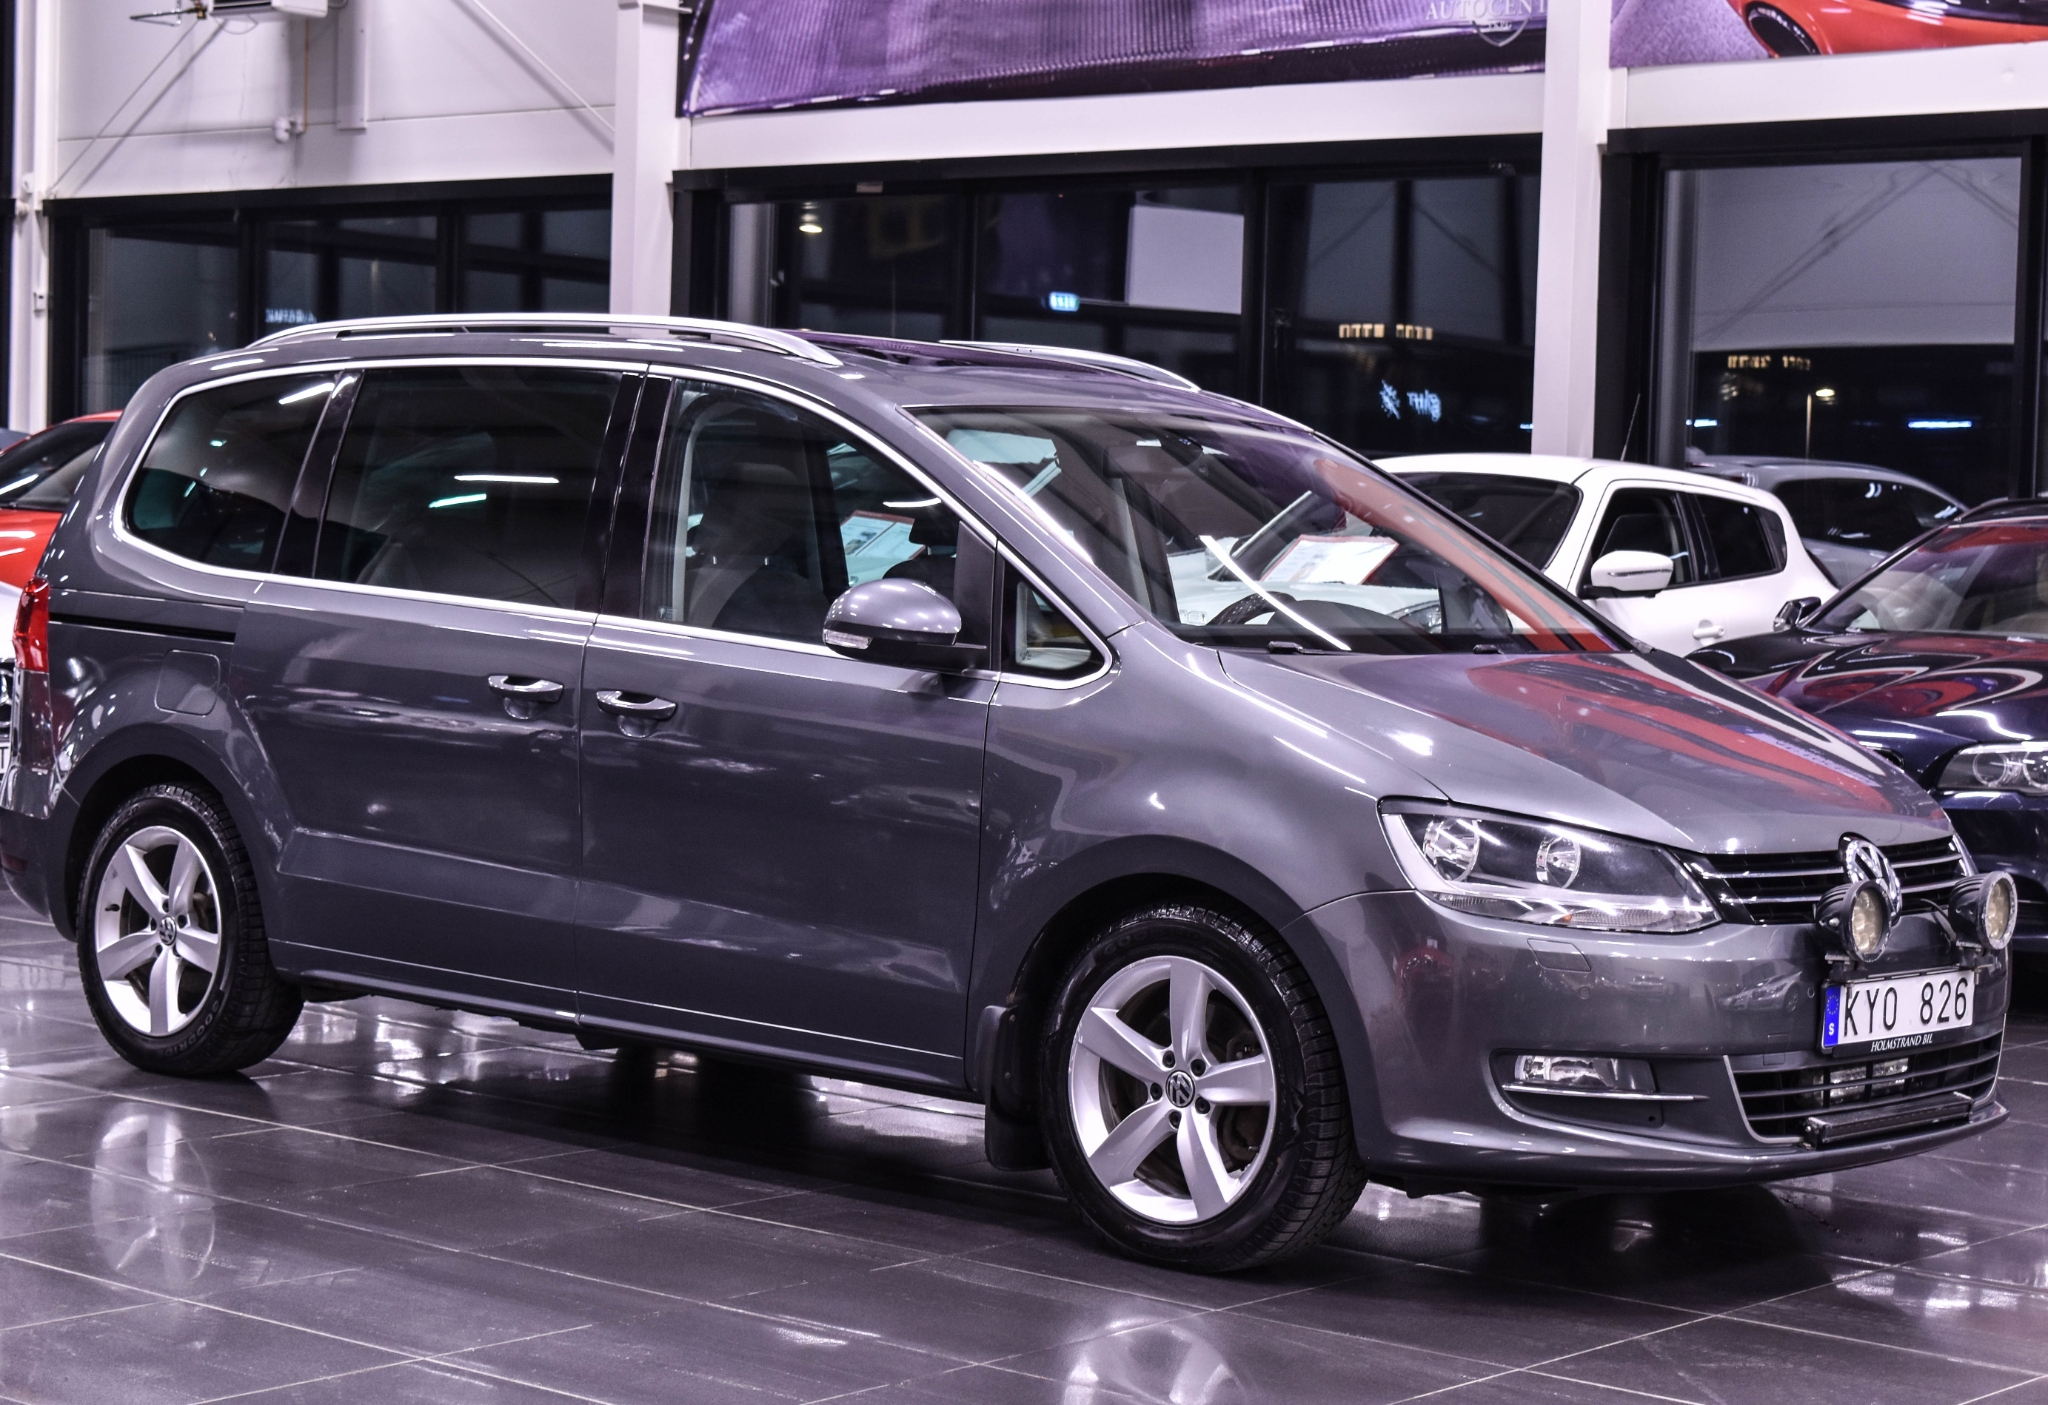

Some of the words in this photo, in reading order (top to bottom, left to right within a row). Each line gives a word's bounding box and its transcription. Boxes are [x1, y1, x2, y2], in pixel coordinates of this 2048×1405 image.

[1843, 985, 1898, 1037] KYO
[1919, 977, 1969, 1026] 826
[1828, 1022, 1835, 1035] S
[1870, 1034, 1922, 1052] HOLMSTRAND
[1922, 1032, 1934, 1045] BIL
